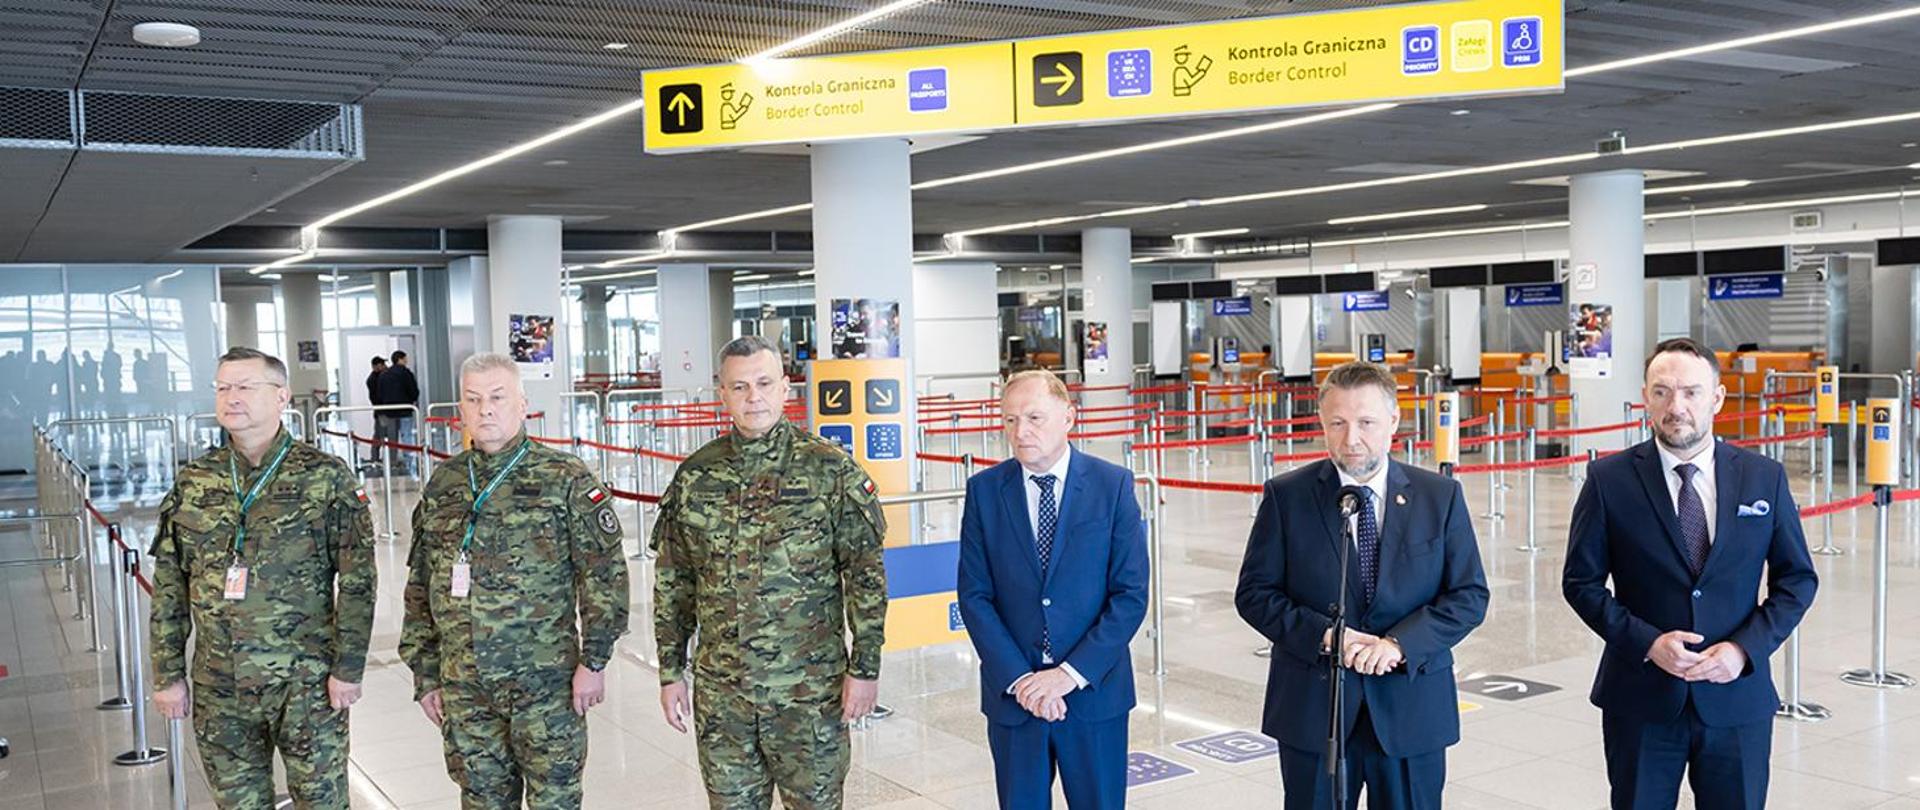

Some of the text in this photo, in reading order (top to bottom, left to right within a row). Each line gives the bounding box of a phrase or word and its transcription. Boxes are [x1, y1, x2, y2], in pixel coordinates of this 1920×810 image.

[1228, 37, 1387, 60] Kontrola Graniczna
[1408, 37, 1433, 53] CD
[1228, 61, 1347, 85] Border Control
[765, 77, 896, 97] Kontrola Graniczna
[766, 100, 864, 120] Border Control
[1224, 738, 1265, 752] CD
